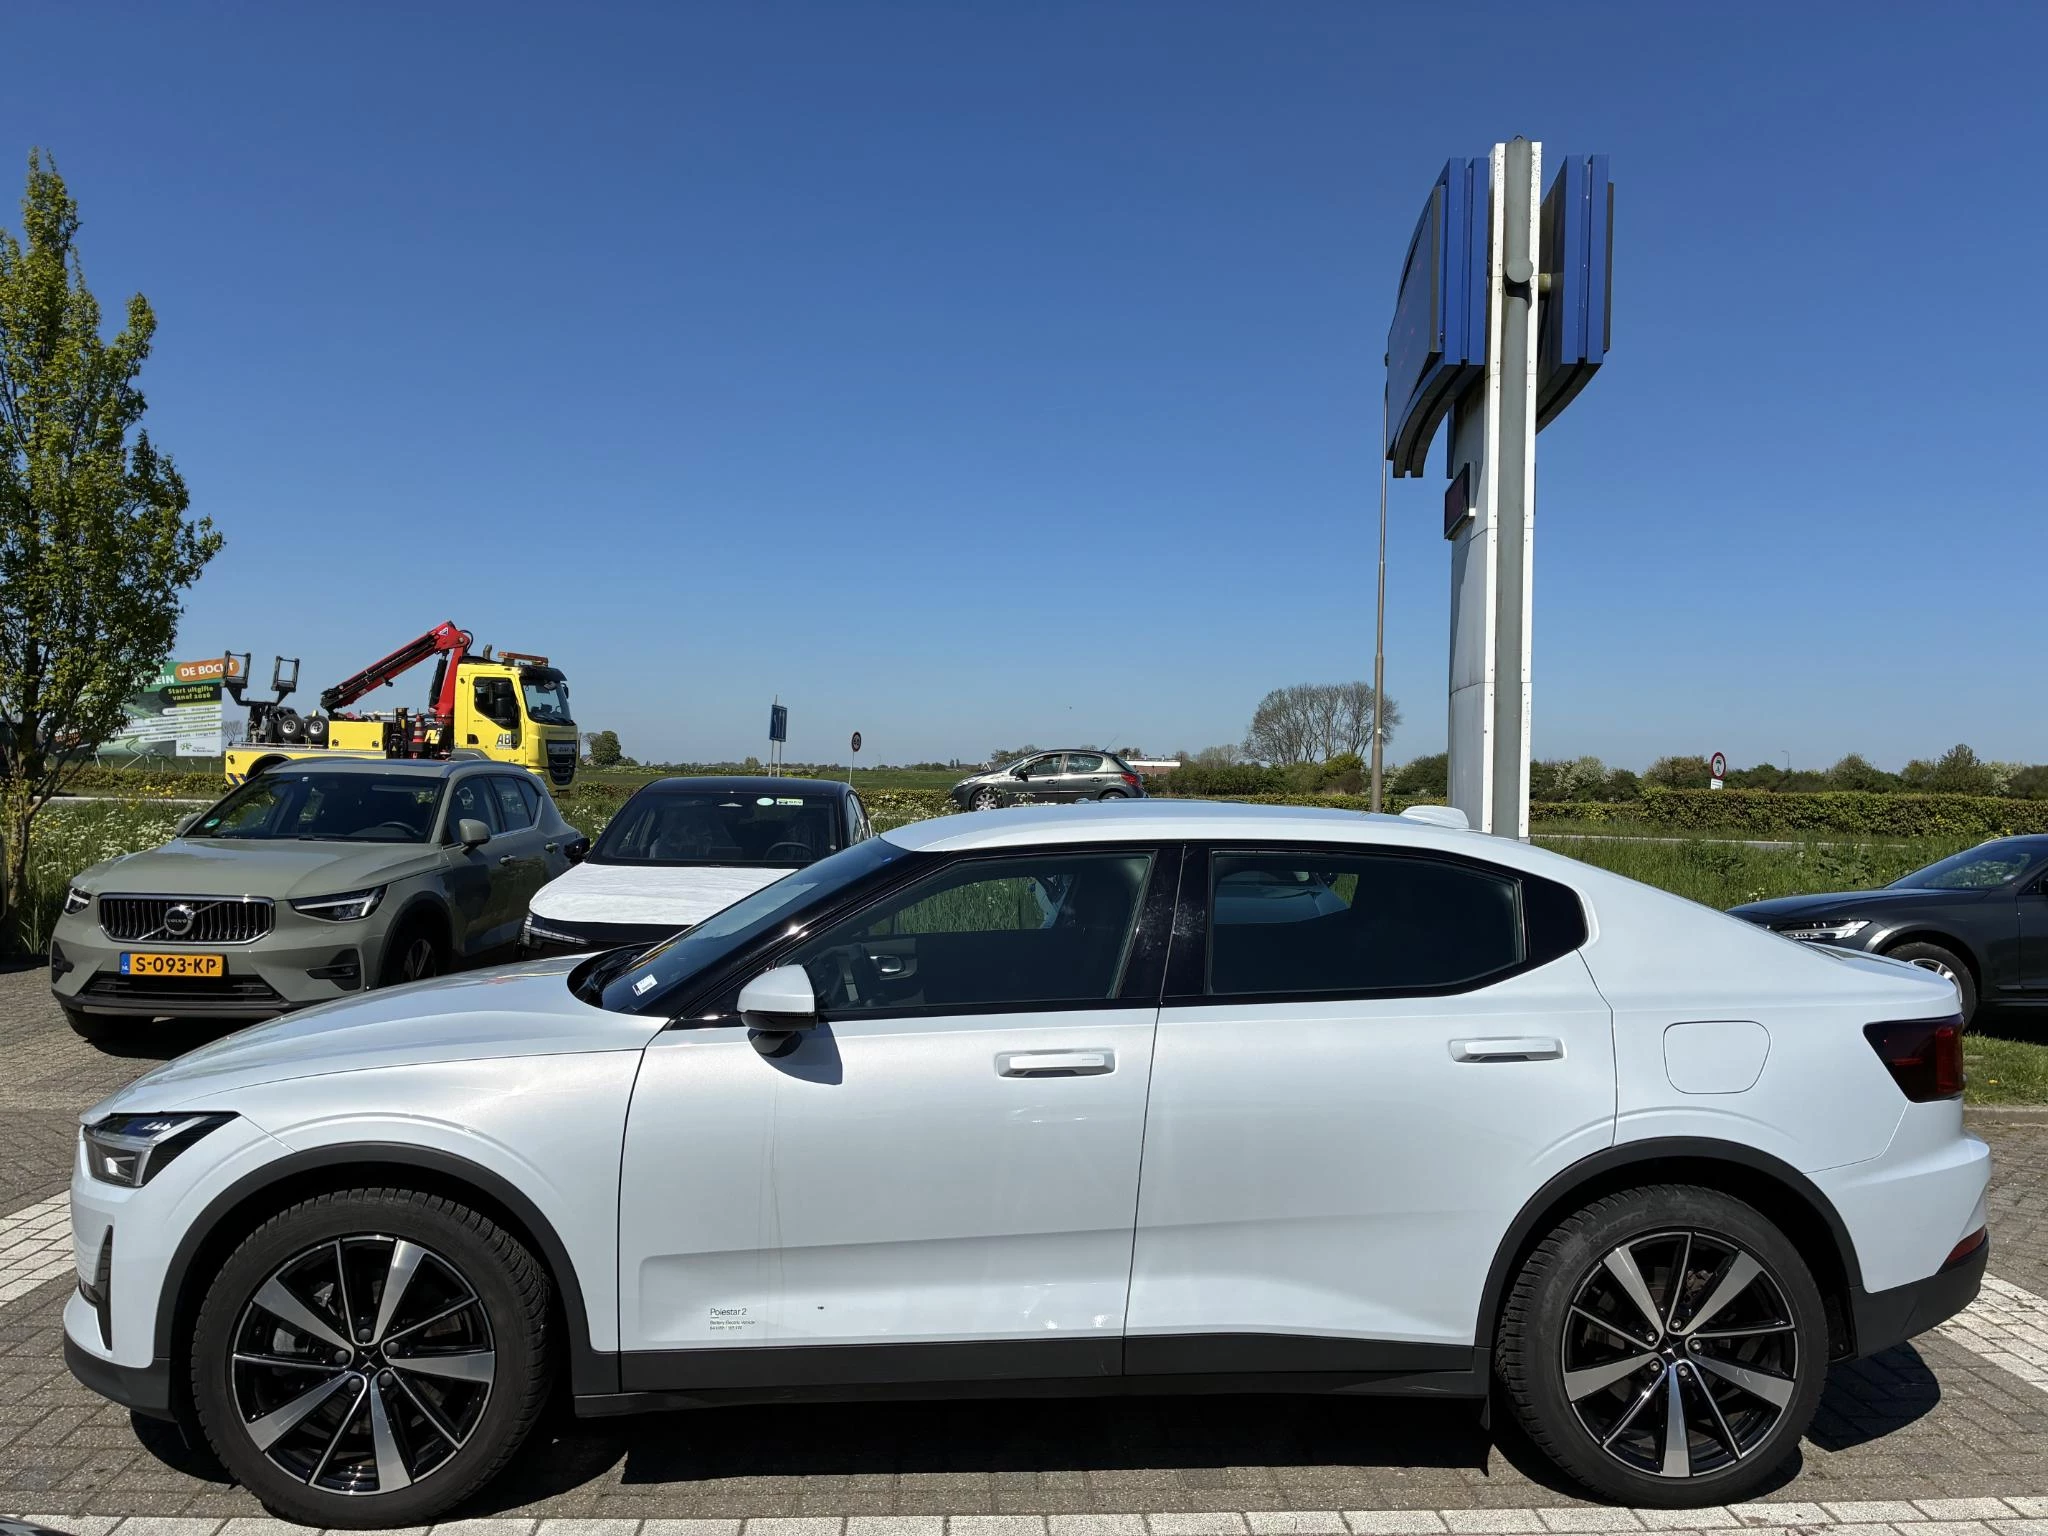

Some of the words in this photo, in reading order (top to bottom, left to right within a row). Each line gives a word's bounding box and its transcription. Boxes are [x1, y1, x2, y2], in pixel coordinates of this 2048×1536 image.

[180, 667, 196, 677] DE
[167, 687, 186, 695] Start
[172, 693, 193, 701] vanaf
[496, 733, 518, 745] ABC
[135, 956, 217, 974] S-093-KP
[710, 1307, 741, 1316] Polestar
[741, 1307, 748, 1316] 2
